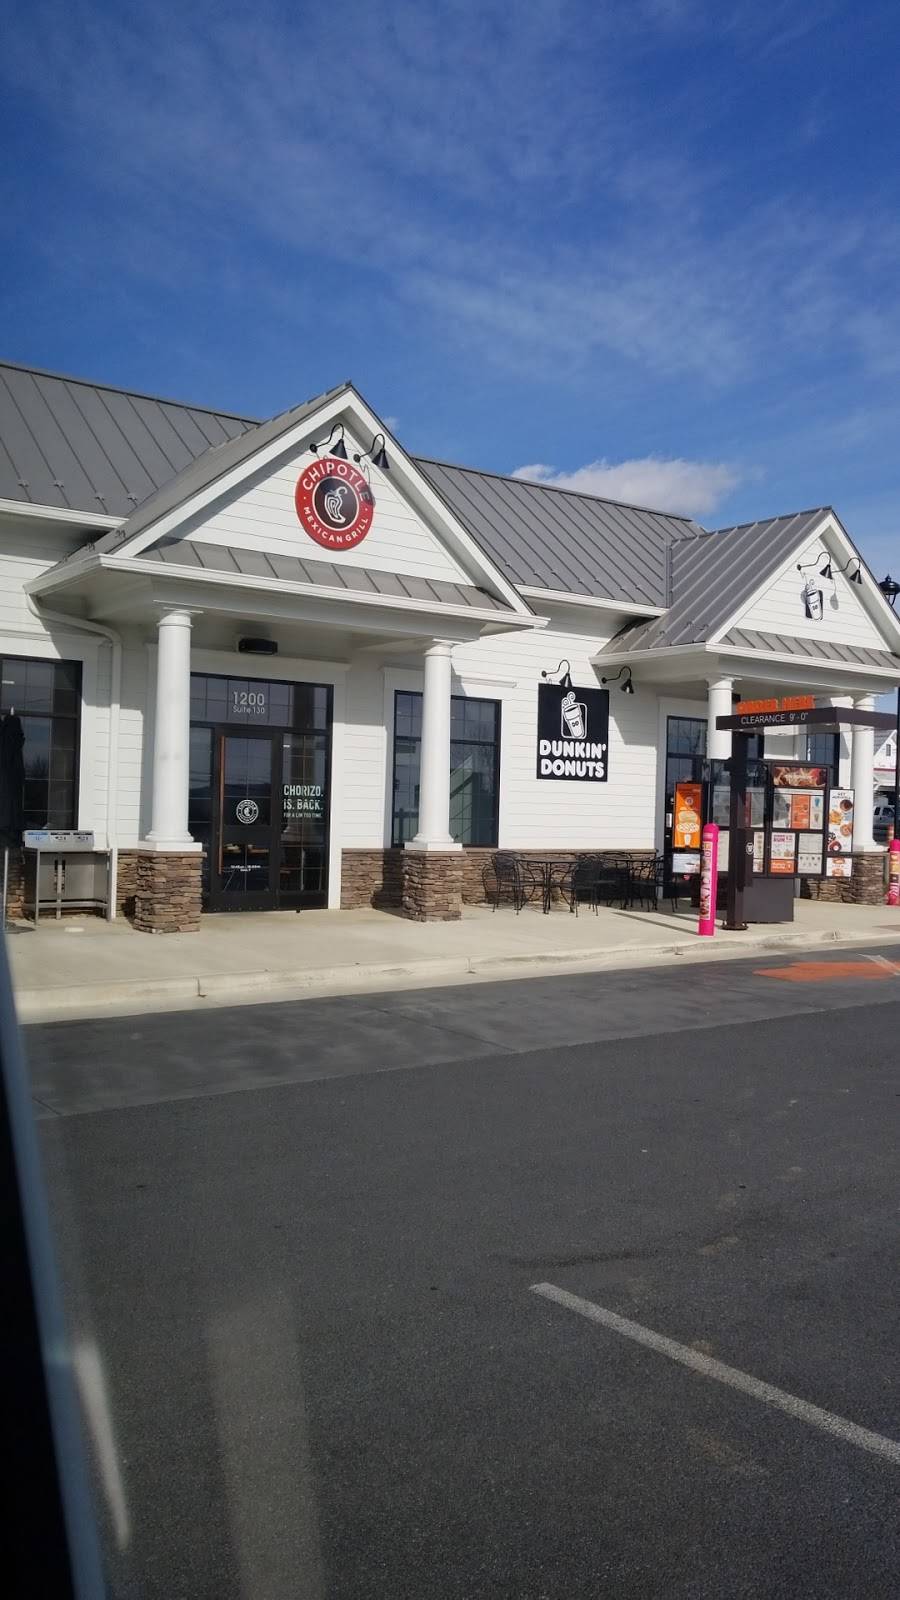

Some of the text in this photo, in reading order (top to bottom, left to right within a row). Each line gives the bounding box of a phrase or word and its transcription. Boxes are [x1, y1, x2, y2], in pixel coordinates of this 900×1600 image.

[302, 461, 370, 502] CHIPOTLE
[303, 507, 368, 543] MEXICAN GRILL
[233, 691, 265, 706] 1200
[233, 705, 265, 714] Suite 130
[741, 713, 786, 725] CLEARANCE
[539, 739, 607, 759] DUNKIN'
[540, 759, 605, 778] DONUTS
[283, 784, 324, 797] CHORIZO.
[283, 798, 324, 811] IS. BACK.
